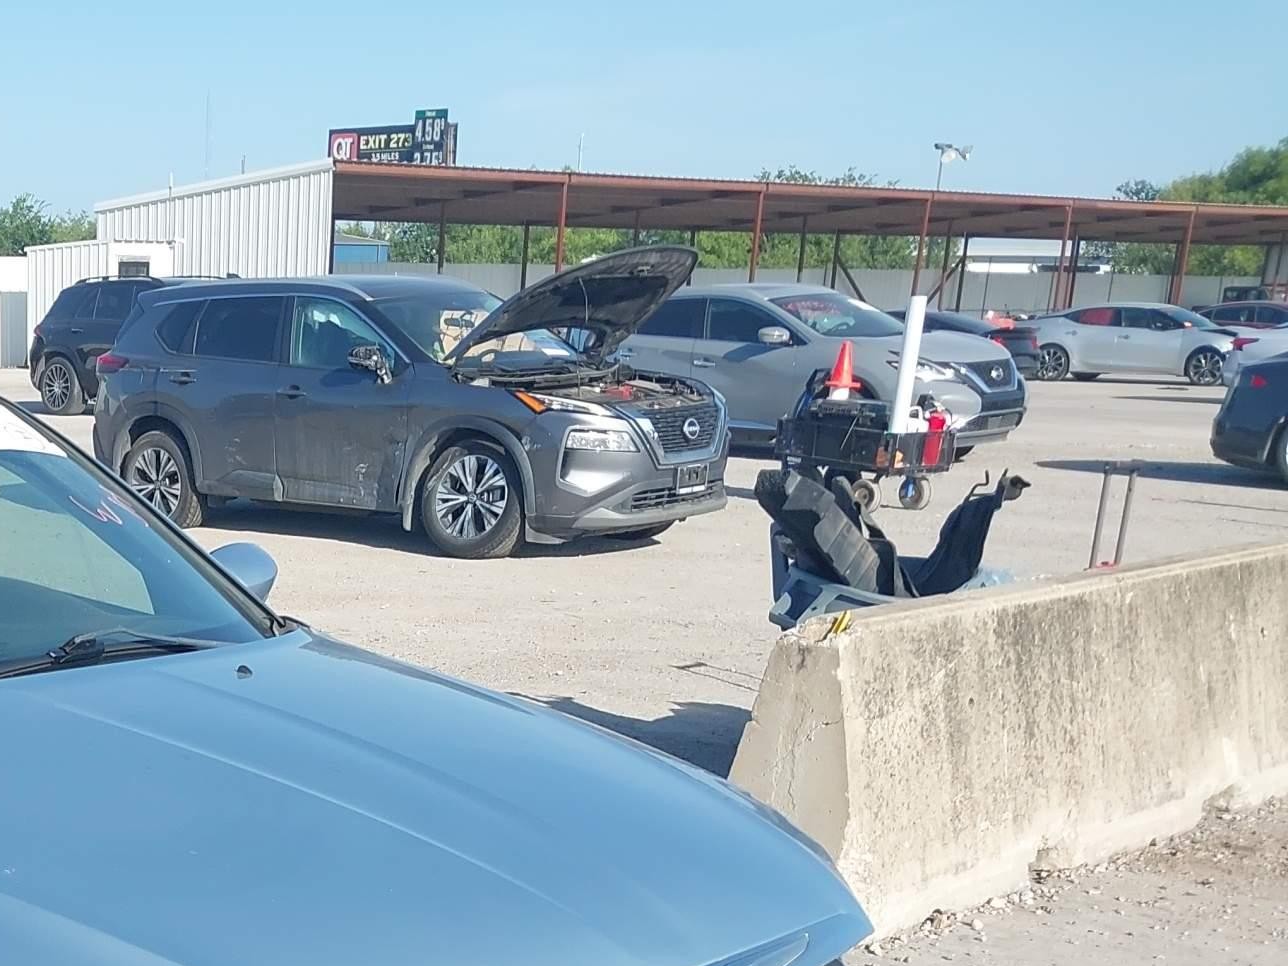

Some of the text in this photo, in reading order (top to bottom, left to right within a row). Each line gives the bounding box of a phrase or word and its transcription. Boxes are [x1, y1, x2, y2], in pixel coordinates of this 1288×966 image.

[333, 137, 353, 160] QT
[360, 135, 387, 149] EXIT
[389, 133, 412, 148] 273
[381, 151, 399, 160] MILES
